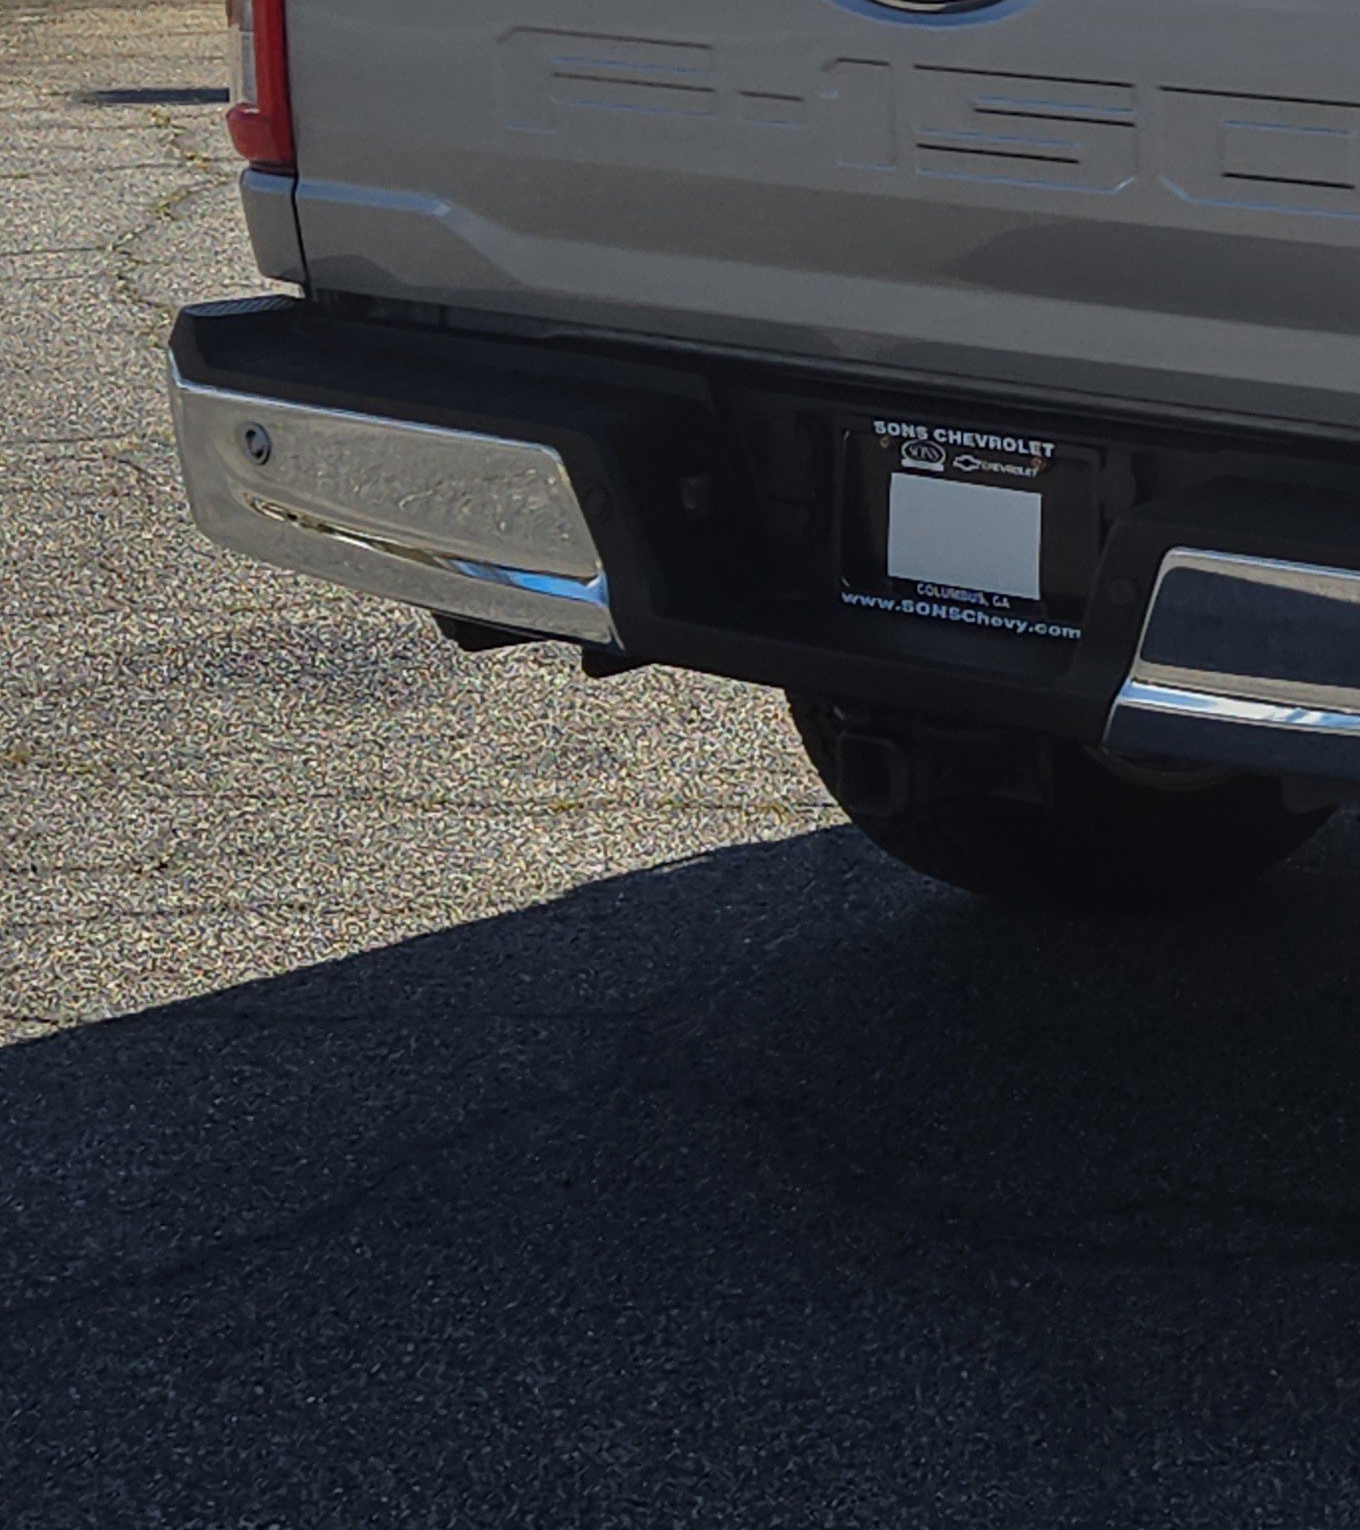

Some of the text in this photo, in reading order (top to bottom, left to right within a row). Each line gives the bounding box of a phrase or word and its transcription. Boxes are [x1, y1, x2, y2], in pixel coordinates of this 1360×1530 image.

[873, 420, 1055, 458] SONS CHEVROLET
[841, 592, 1082, 639] www.SONSChevy.com
